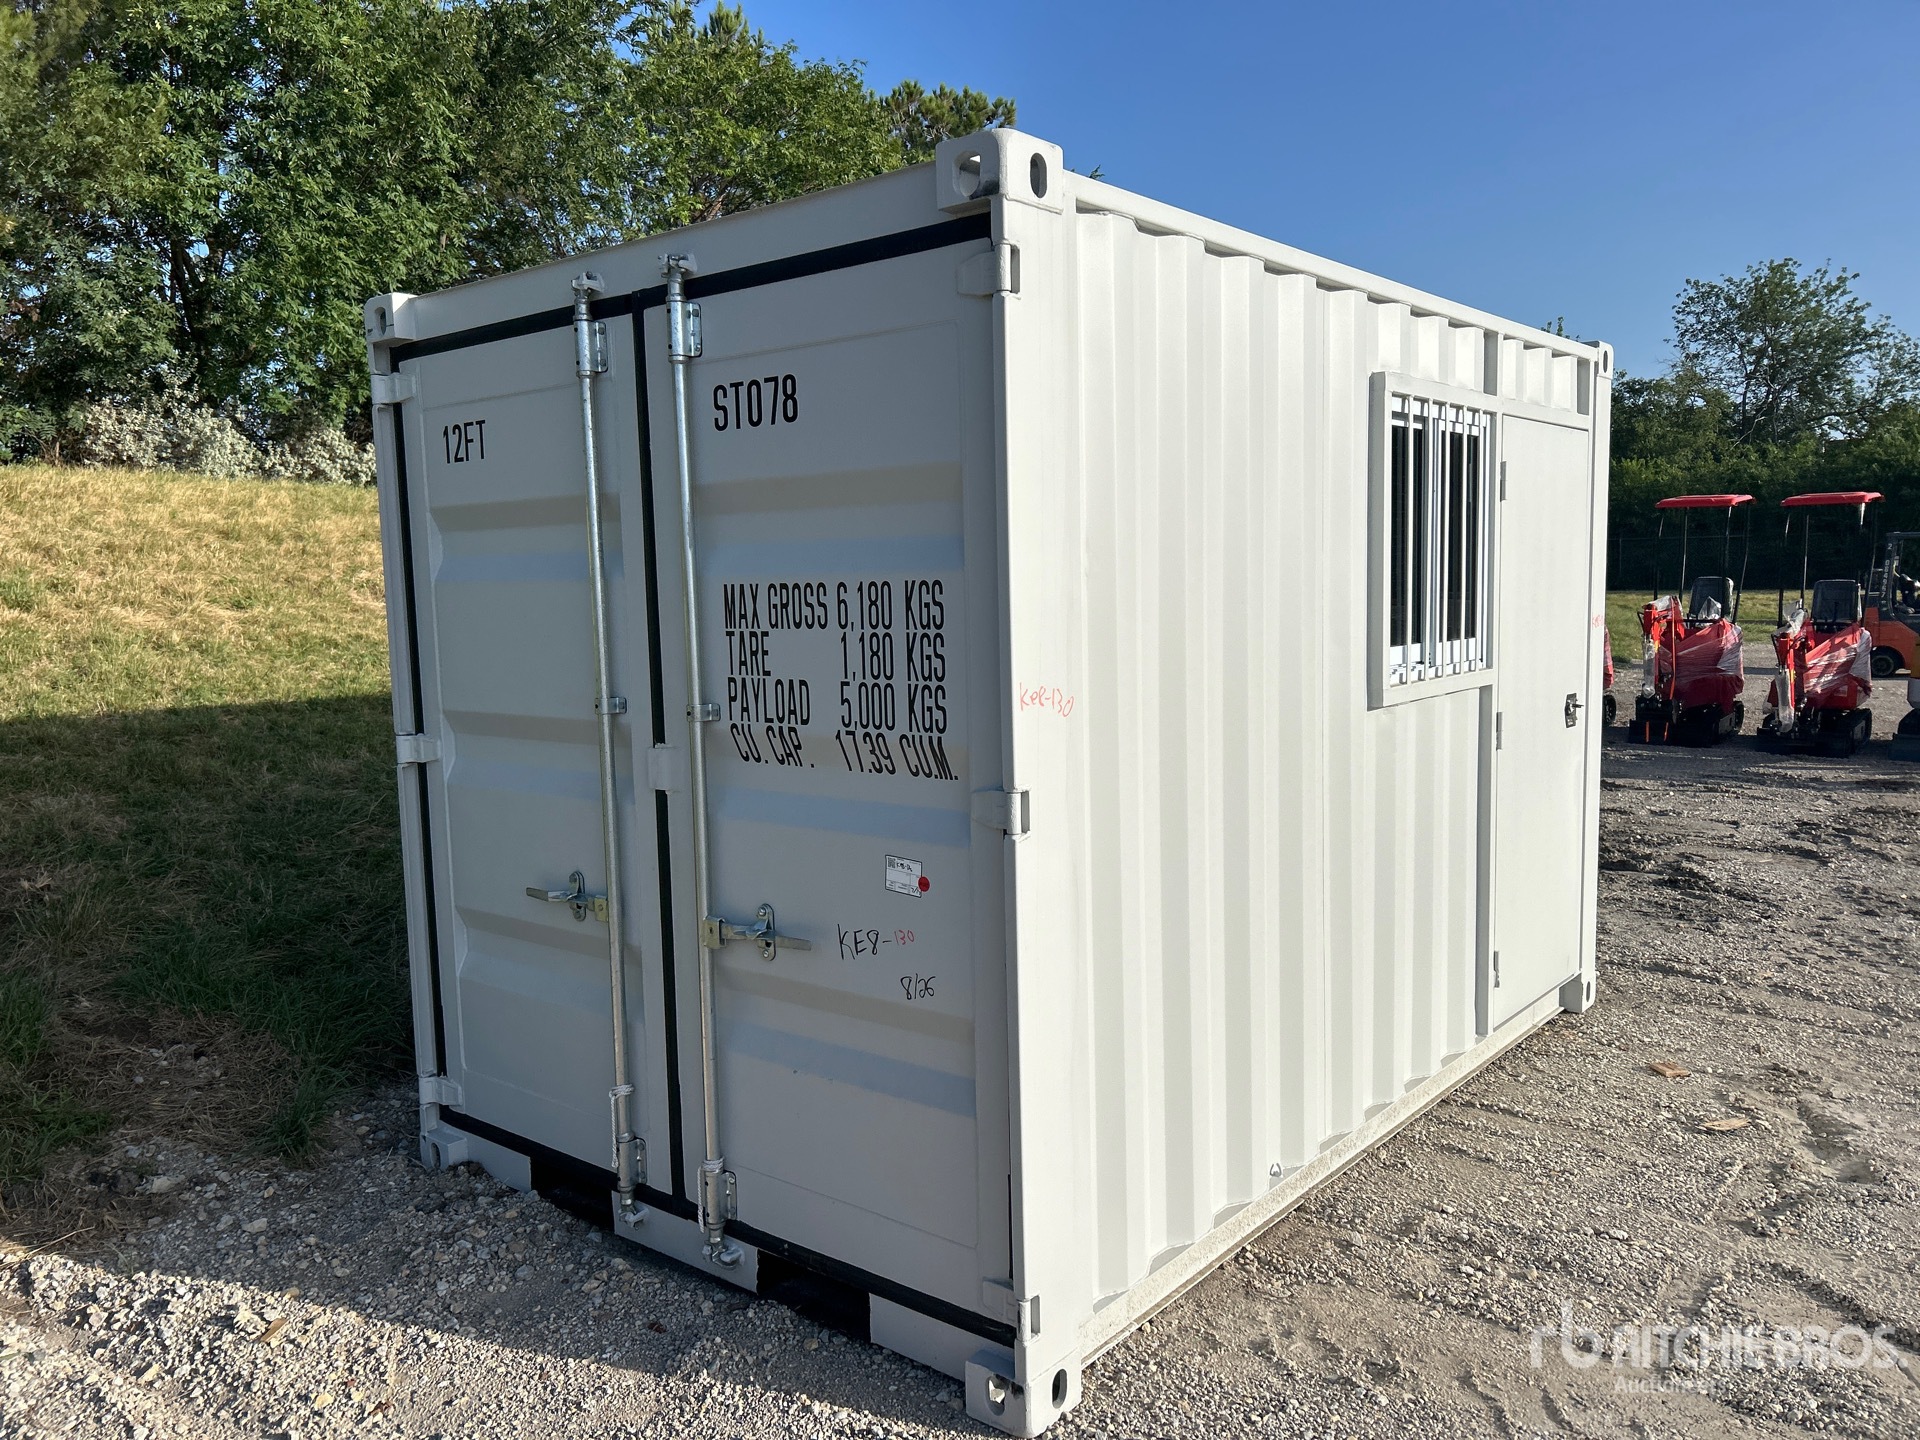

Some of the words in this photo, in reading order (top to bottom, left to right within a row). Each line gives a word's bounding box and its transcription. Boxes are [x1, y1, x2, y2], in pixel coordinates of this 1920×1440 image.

[442, 419, 487, 464] 12FT
[723, 583, 761, 630] MAX
[767, 581, 829, 630] GROSS
[836, 580, 893, 632] 6,180
[904, 579, 946, 631] KGS
[725, 630, 772, 677] TARE
[840, 632, 895, 682] 1,180
[905, 631, 946, 683] KGS
[727, 677, 811, 726] PAYLOAD
[840, 680, 896, 732] 5,000
[907, 684, 948, 735] KGS
[729, 722, 770, 765] CU.
[835, 729, 897, 776] 17.39
[900, 972, 936, 1001] 8/26
